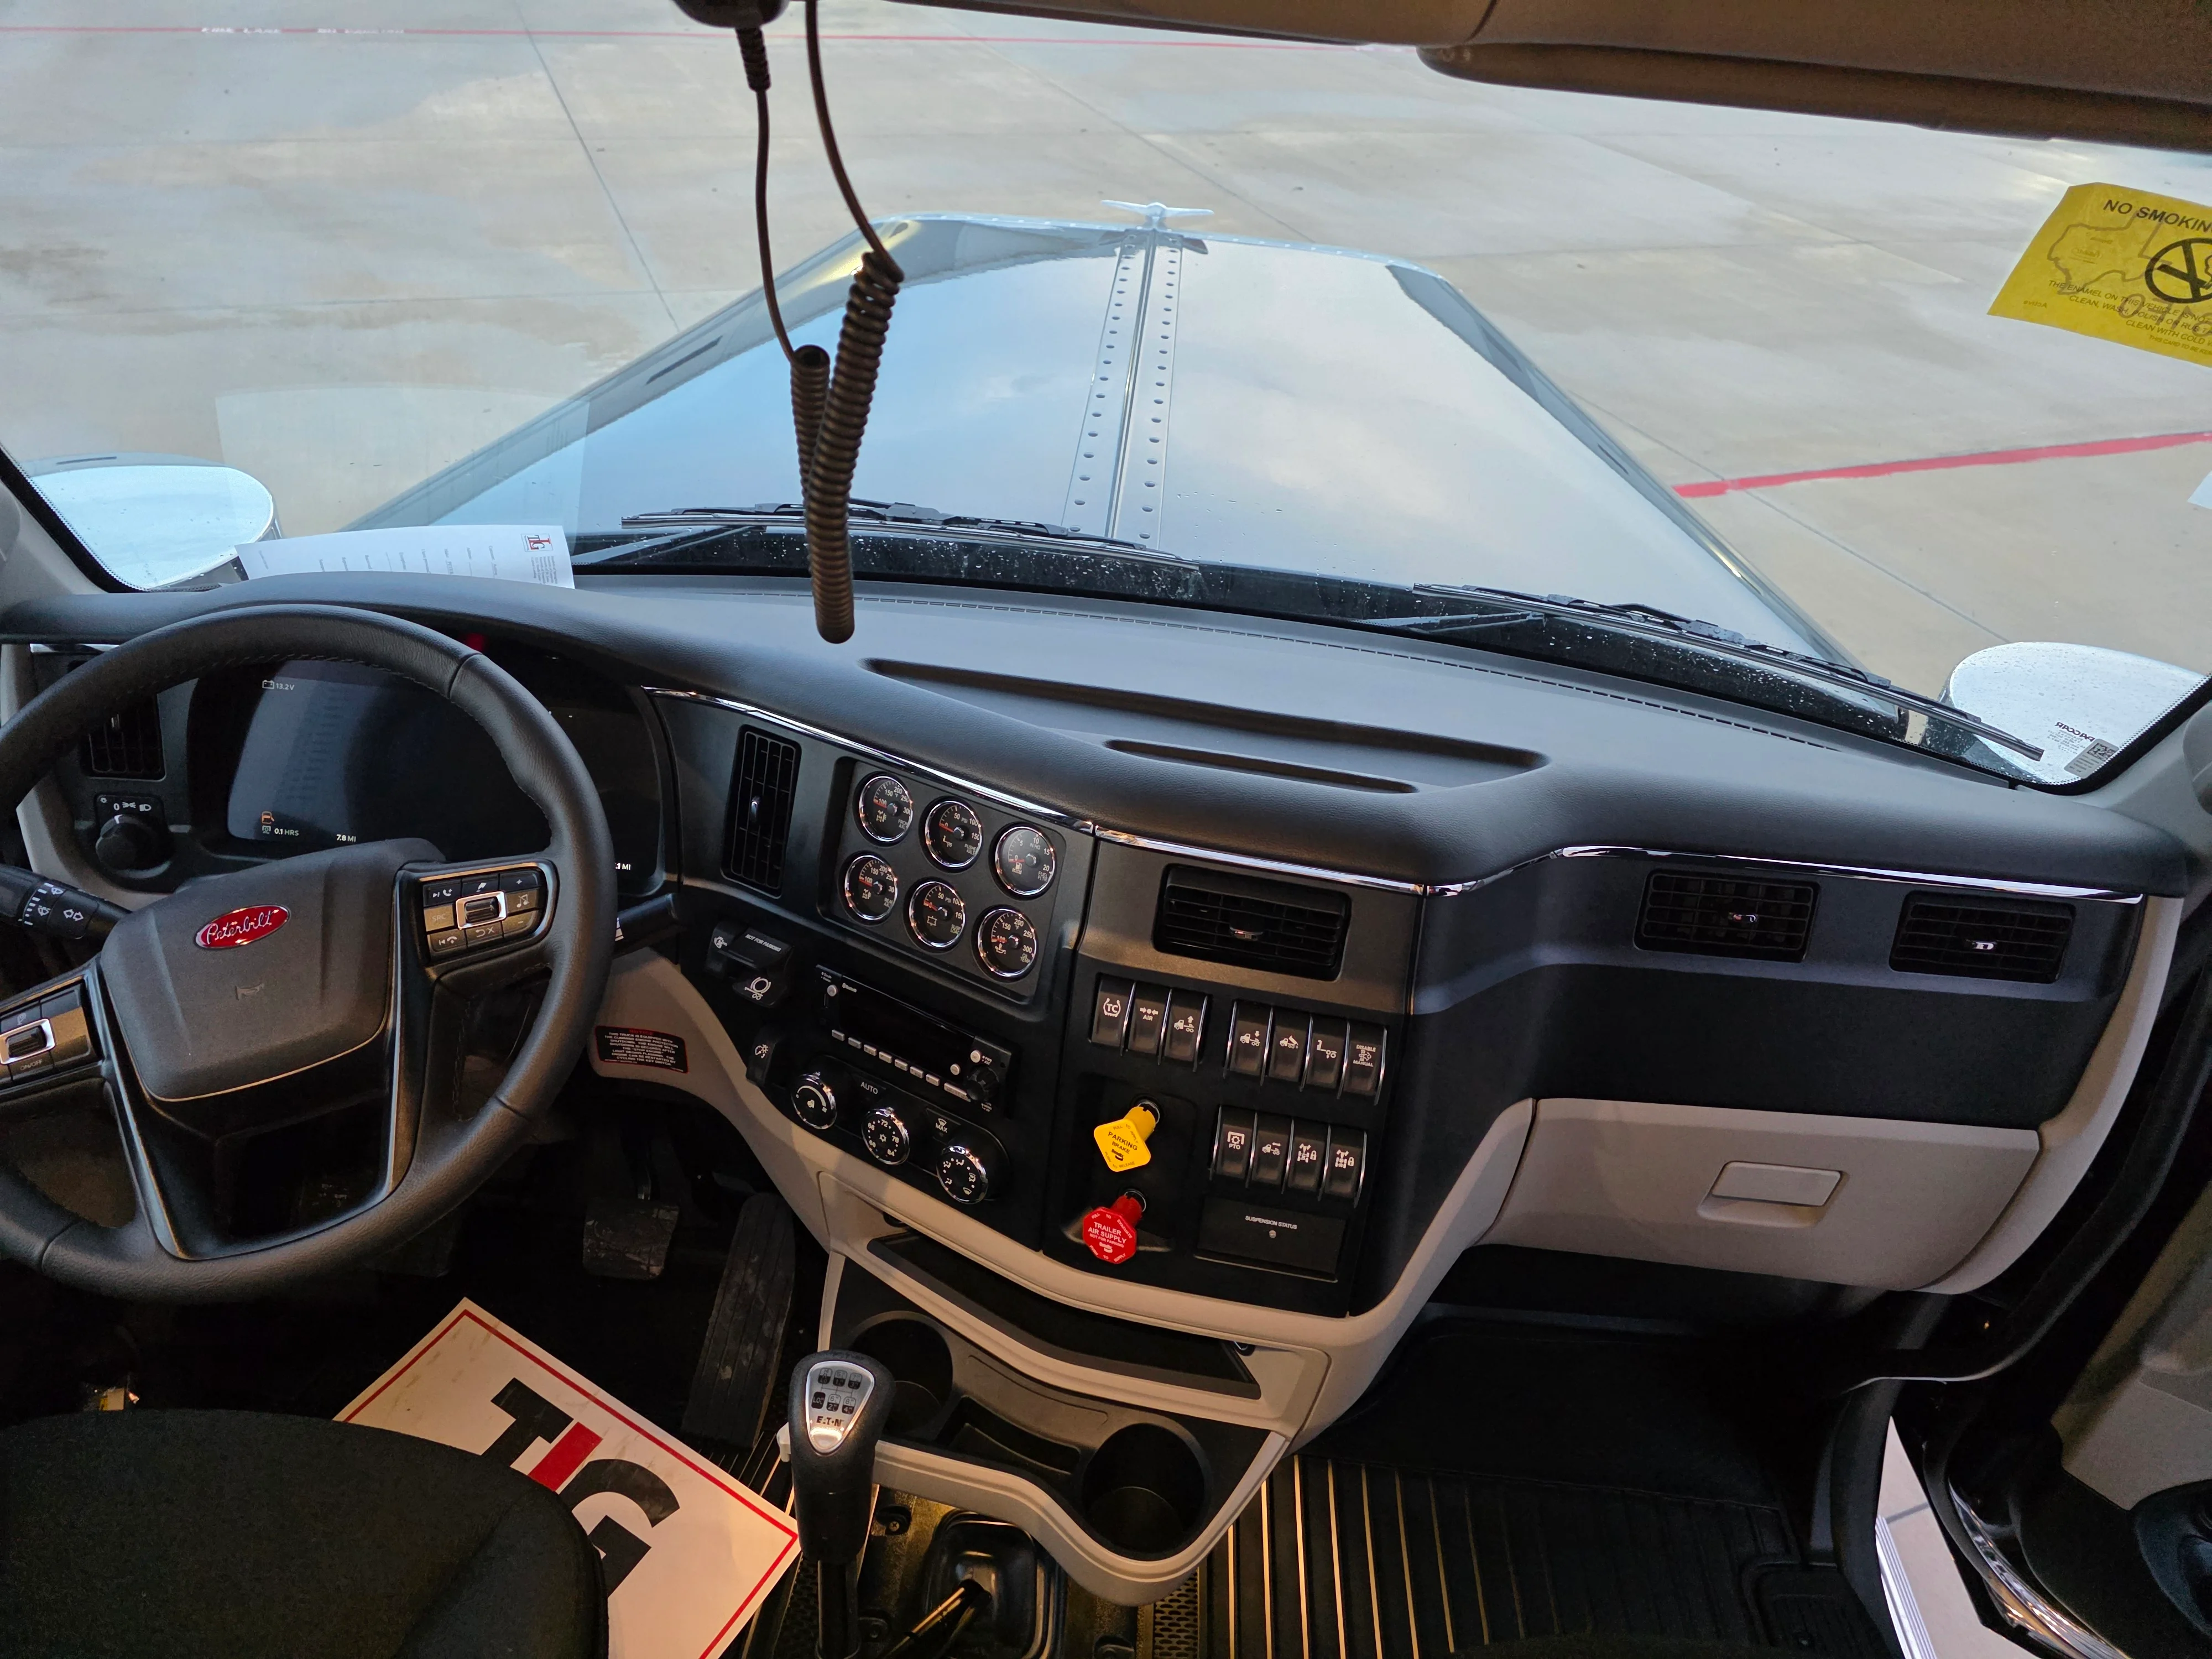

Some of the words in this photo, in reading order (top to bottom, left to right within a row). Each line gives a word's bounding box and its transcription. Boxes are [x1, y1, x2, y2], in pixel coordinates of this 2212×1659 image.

[2103, 199, 2133, 215] NO
[2136, 207, 2212, 233] SMOKIN
[2048, 280, 2065, 289] THE
[2068, 283, 2102, 299] ENAMEL
[2104, 292, 2118, 301] ON
[2120, 295, 2140, 306] THIS
[2142, 301, 2180, 316] VEHICLE
[2126, 319, 2156, 331] CLEAN
[2157, 327, 2179, 337] WITH
[2180, 333, 2205, 345] COLD
[870, 867, 879, 875] 150
[879, 865, 888, 873] 200
[432, 912, 447, 922] SRC
[206, 909, 279, 945] Peterbilt
[1002, 922, 1011, 931] 150
[1014, 918, 1024, 927] 200
[1023, 930, 1033, 938] 250
[1022, 945, 1032, 953] 300
[1107, 1003, 1118, 1013] TC
[1356, 1044, 1376, 1052] DISABLE
[860, 1081, 878, 1094] AUTO
[881, 1119, 888, 1128] 72
[935, 1123, 948, 1133] MAX
[1108, 1131, 1138, 1151] PARKING
[1112, 1141, 1130, 1154] BRAKE
[1245, 1215, 1277, 1226] SUSPENSION
[1278, 1222, 1297, 1230] STATUS
[1094, 1222, 1121, 1236] TRAILER
[1088, 1227, 1099, 1235] AIR
[1100, 1231, 1127, 1244] SUPPLY
[1107, 1239, 1124, 1248] PARKING
